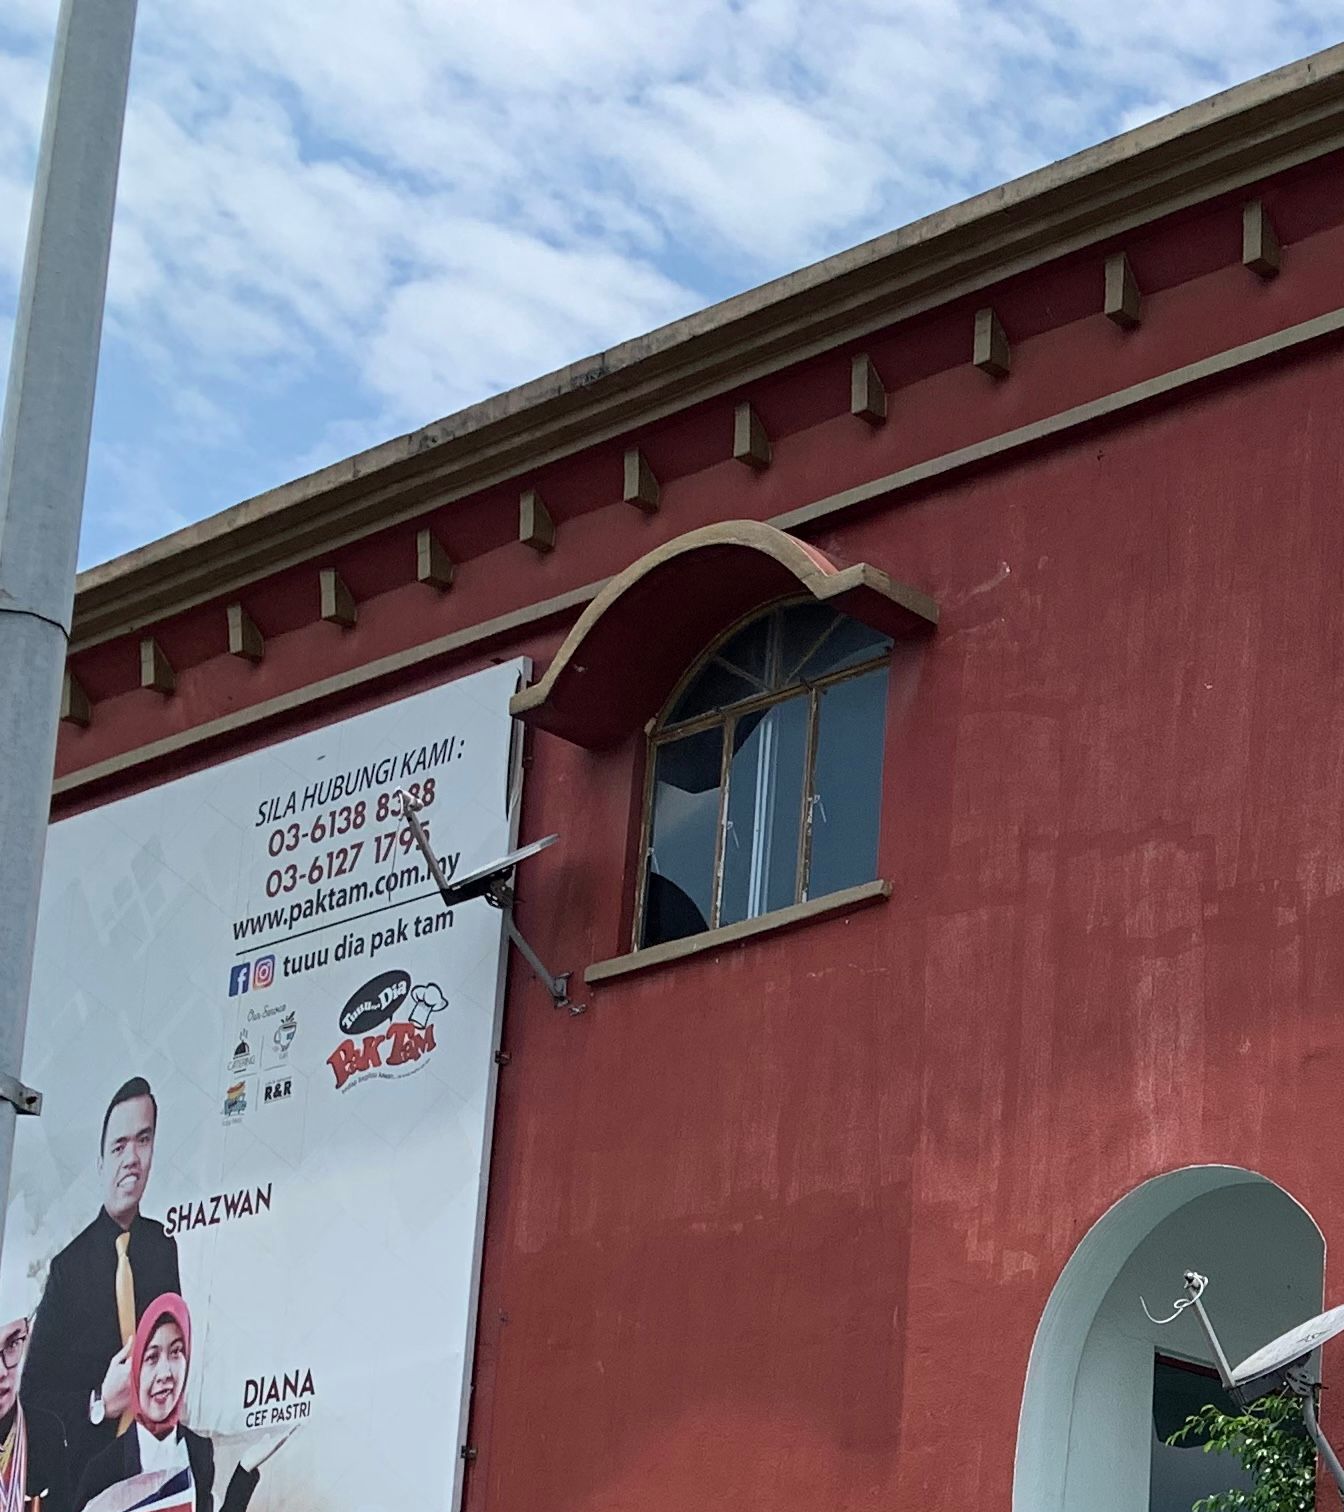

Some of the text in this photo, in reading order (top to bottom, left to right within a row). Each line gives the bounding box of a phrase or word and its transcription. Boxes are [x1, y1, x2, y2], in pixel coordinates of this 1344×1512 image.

[255, 791, 297, 827] SILA
[301, 756, 398, 811] HUBUNGI
[268, 801, 366, 857] 03-6138
[232, 852, 461, 941] www.paktam.com.my
[265, 841, 365, 898] 03-6127
[283, 910, 454, 977] tuuu dia pak tam
[165, 1183, 272, 1236] SHAZWAN
[243, 1368, 315, 1408] DIANA
[245, 1401, 311, 1428] CEF PASTRI
